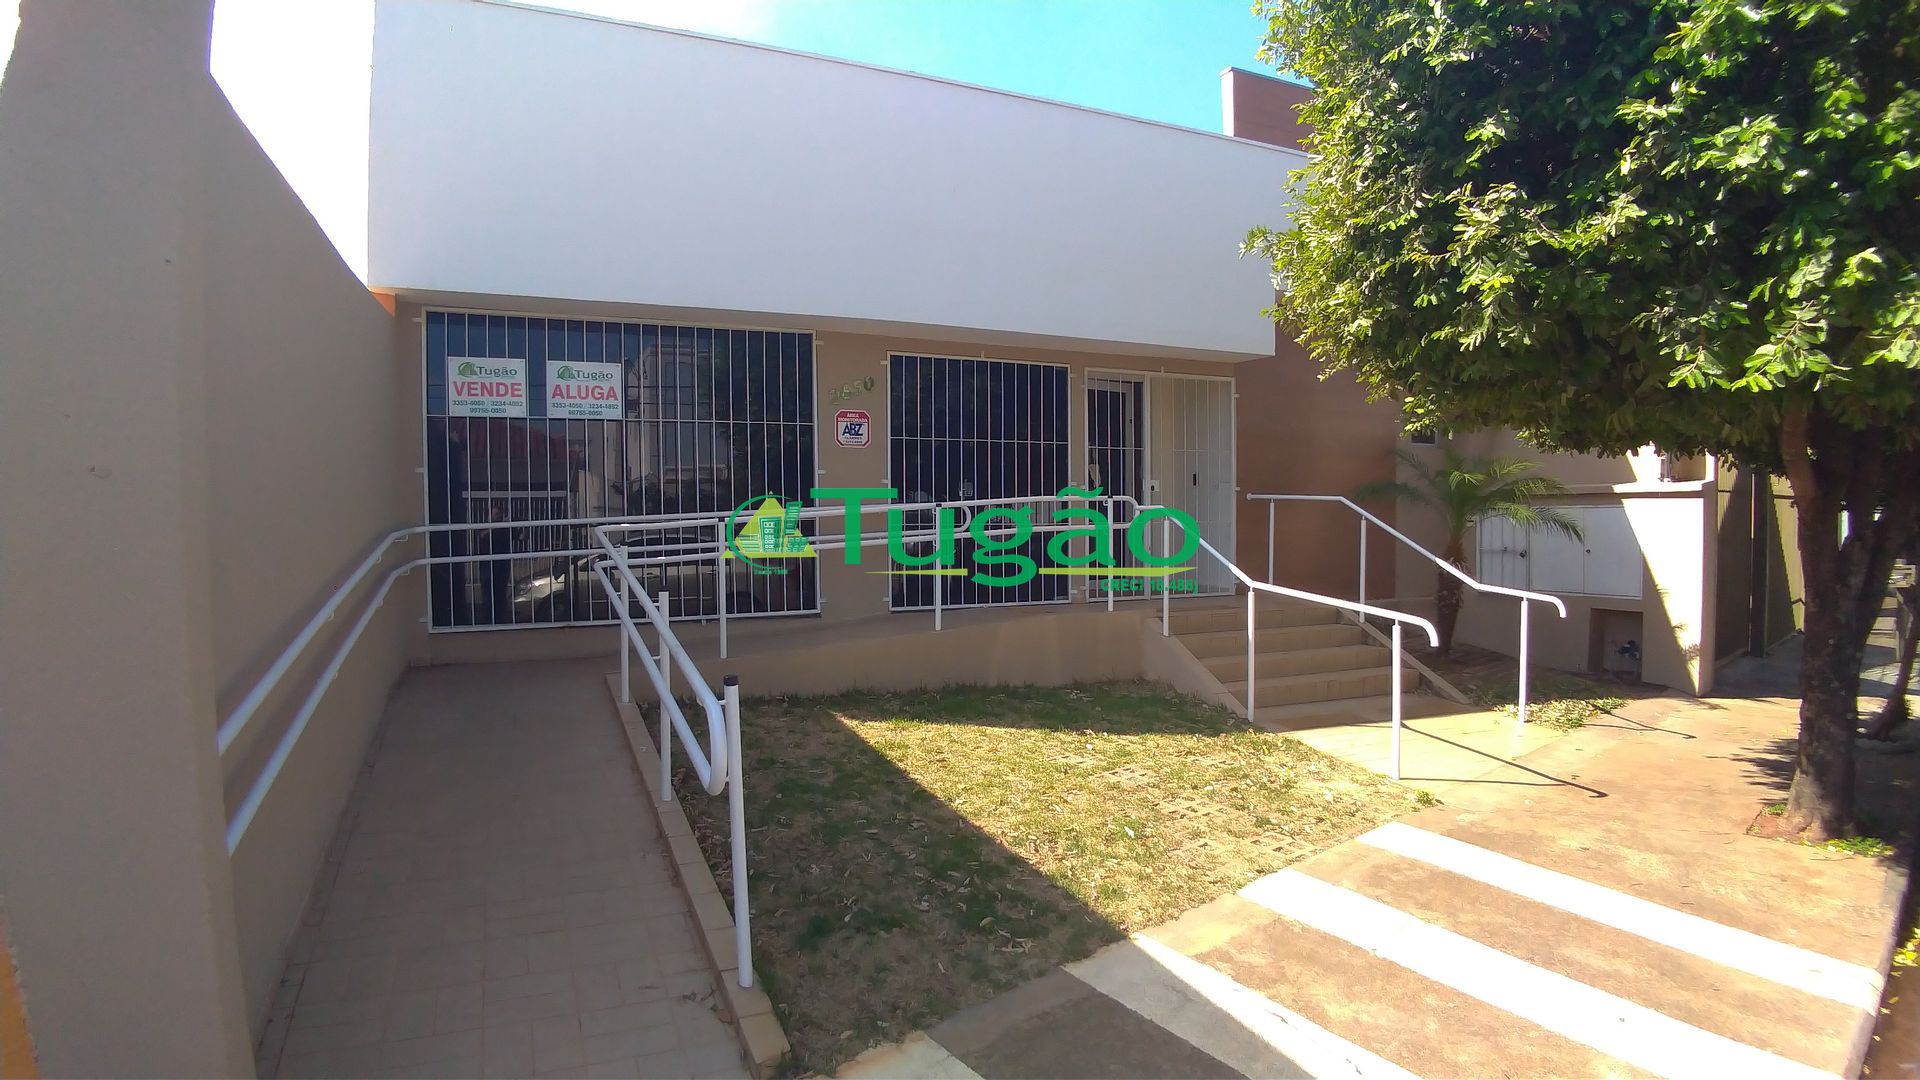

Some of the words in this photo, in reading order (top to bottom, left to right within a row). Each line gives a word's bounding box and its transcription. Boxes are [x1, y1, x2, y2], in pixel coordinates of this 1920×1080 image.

[476, 366, 517, 378] Tugão
[574, 369, 613, 381] Tugão
[452, 380, 523, 398] VENDE
[551, 383, 619, 401] ALUGA
[842, 422, 864, 436] ABZ
